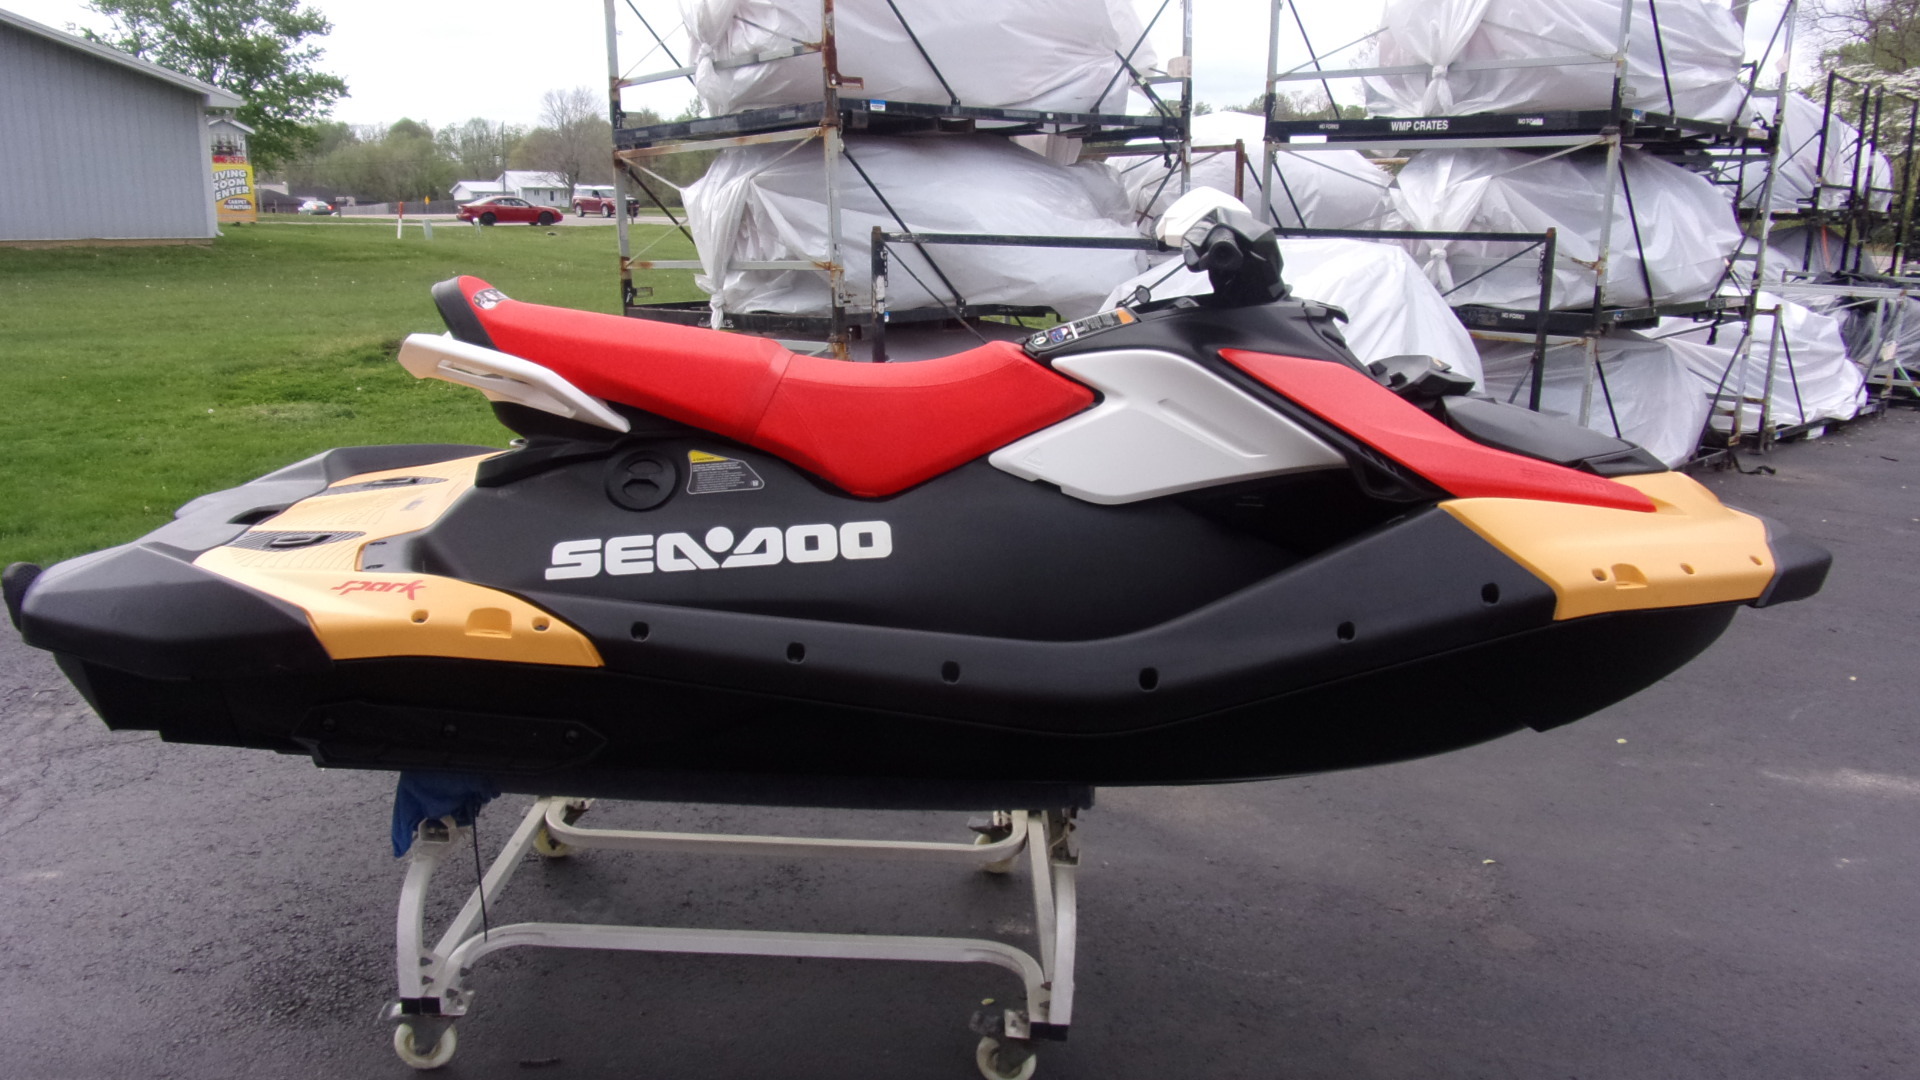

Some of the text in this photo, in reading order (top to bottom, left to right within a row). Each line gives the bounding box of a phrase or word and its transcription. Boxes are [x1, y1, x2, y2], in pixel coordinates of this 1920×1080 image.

[1391, 120, 1449, 131] WMP CRATES
[213, 170, 247, 180] IVING
